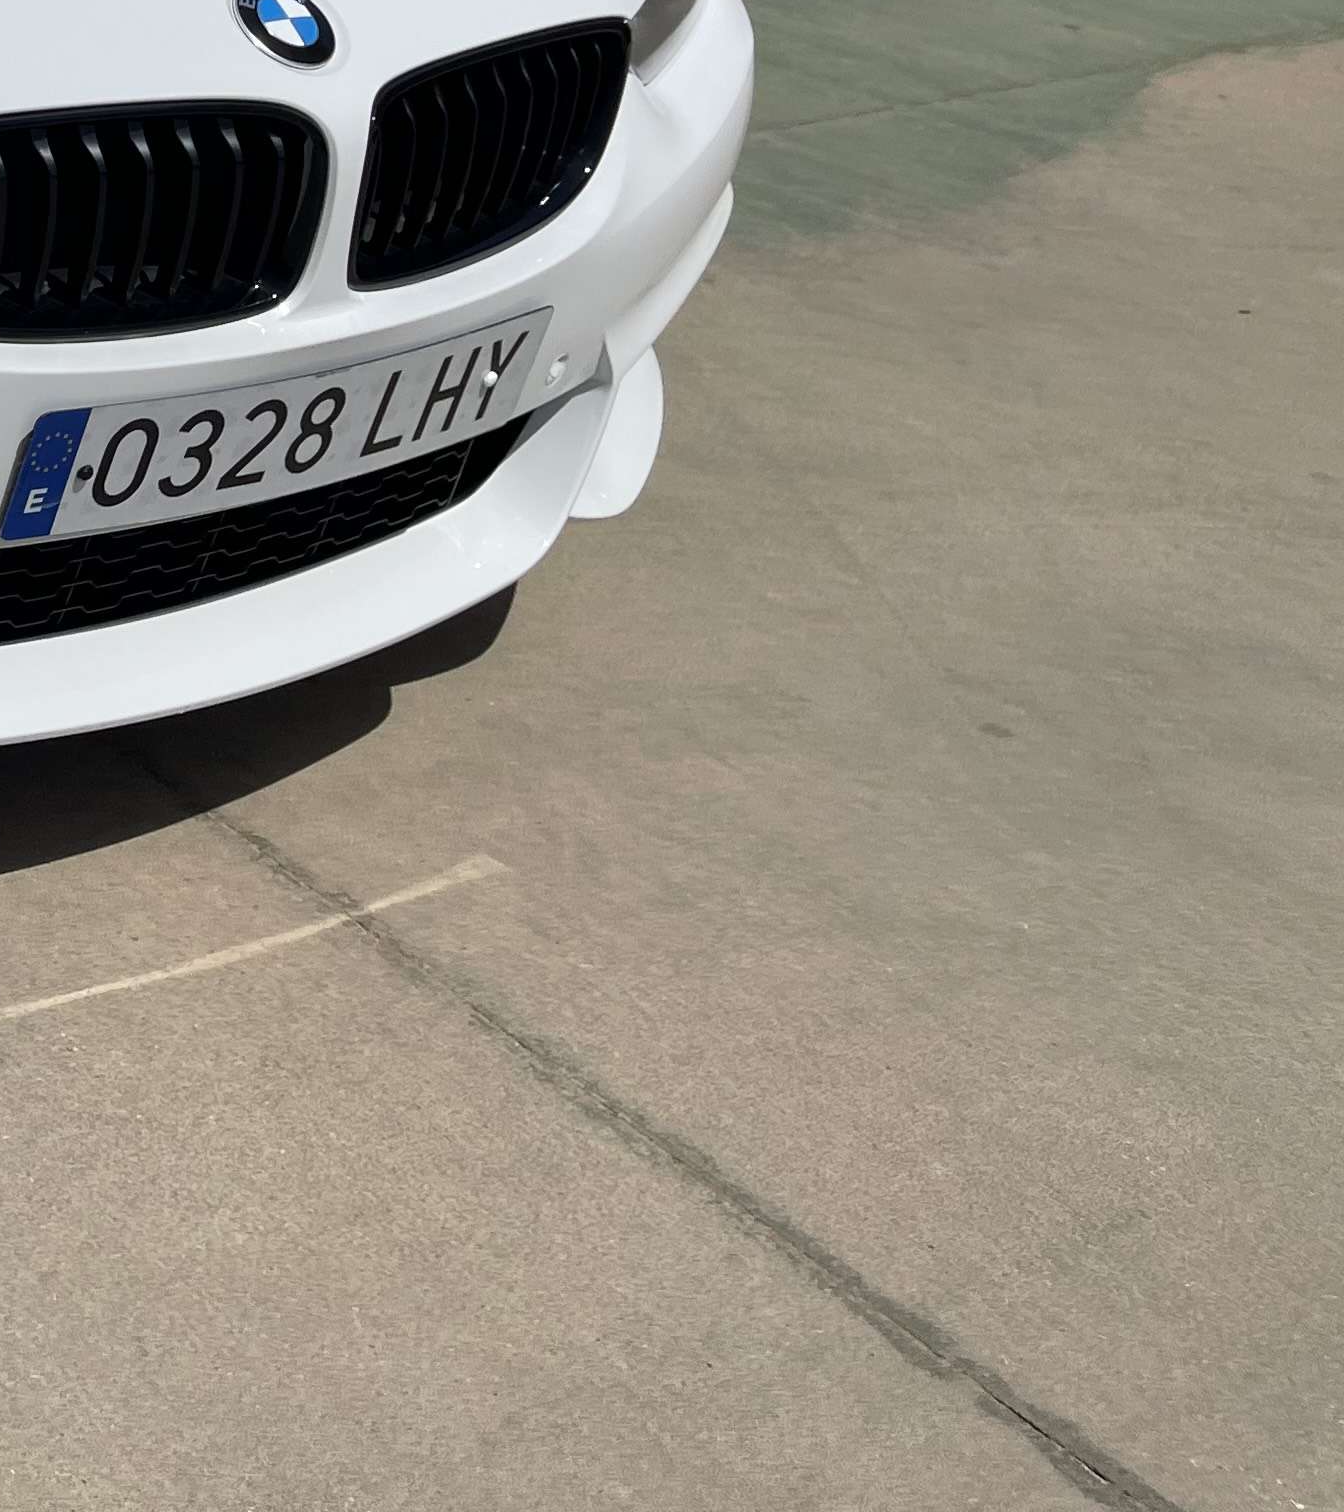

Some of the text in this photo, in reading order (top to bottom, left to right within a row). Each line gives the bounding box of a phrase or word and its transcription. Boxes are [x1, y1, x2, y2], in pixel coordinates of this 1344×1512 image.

[92, 330, 530, 507] 0328 LHY
[23, 488, 49, 513] E
